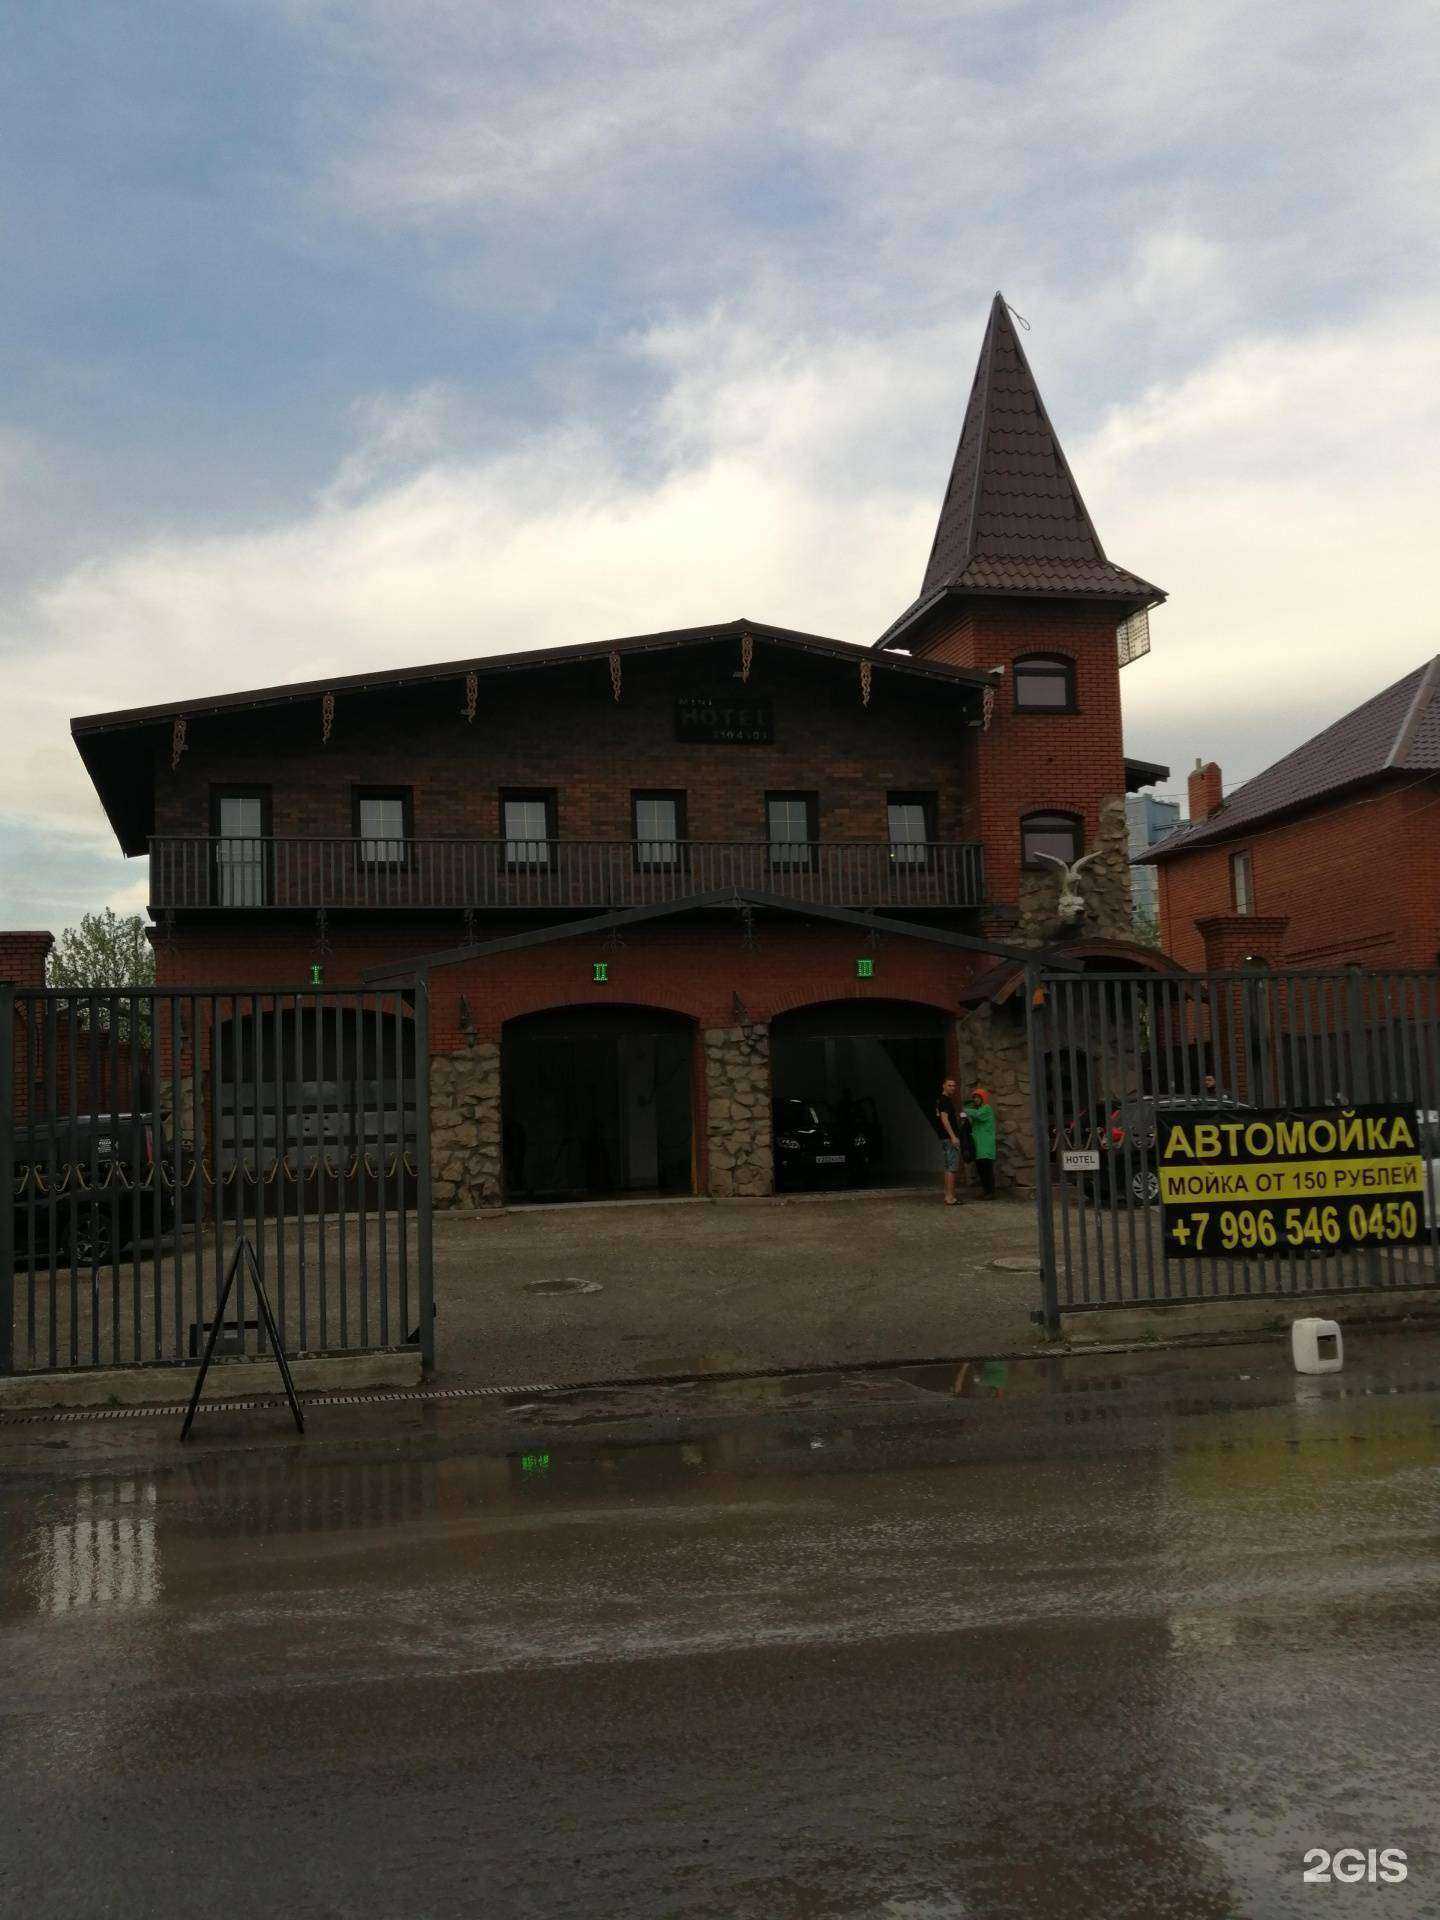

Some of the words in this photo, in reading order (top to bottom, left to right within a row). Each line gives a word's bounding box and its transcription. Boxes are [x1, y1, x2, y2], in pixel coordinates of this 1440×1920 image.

[1163, 1110, 1415, 1159] АВТОМОЙКА
[1066, 1155, 1096, 1164] HOTEL
[1168, 1171, 1249, 1196] МОЙКА
[1256, 1173, 1285, 1192] ОТ
[1293, 1171, 1327, 1190] 150
[1334, 1162, 1417, 1188] РУБЛЕЙ
[1172, 1212, 1210, 1250] +7
[1219, 1208, 1278, 1249] 996
[1285, 1205, 1341, 1246] 546
[1348, 1201, 1418, 1241] 0450
